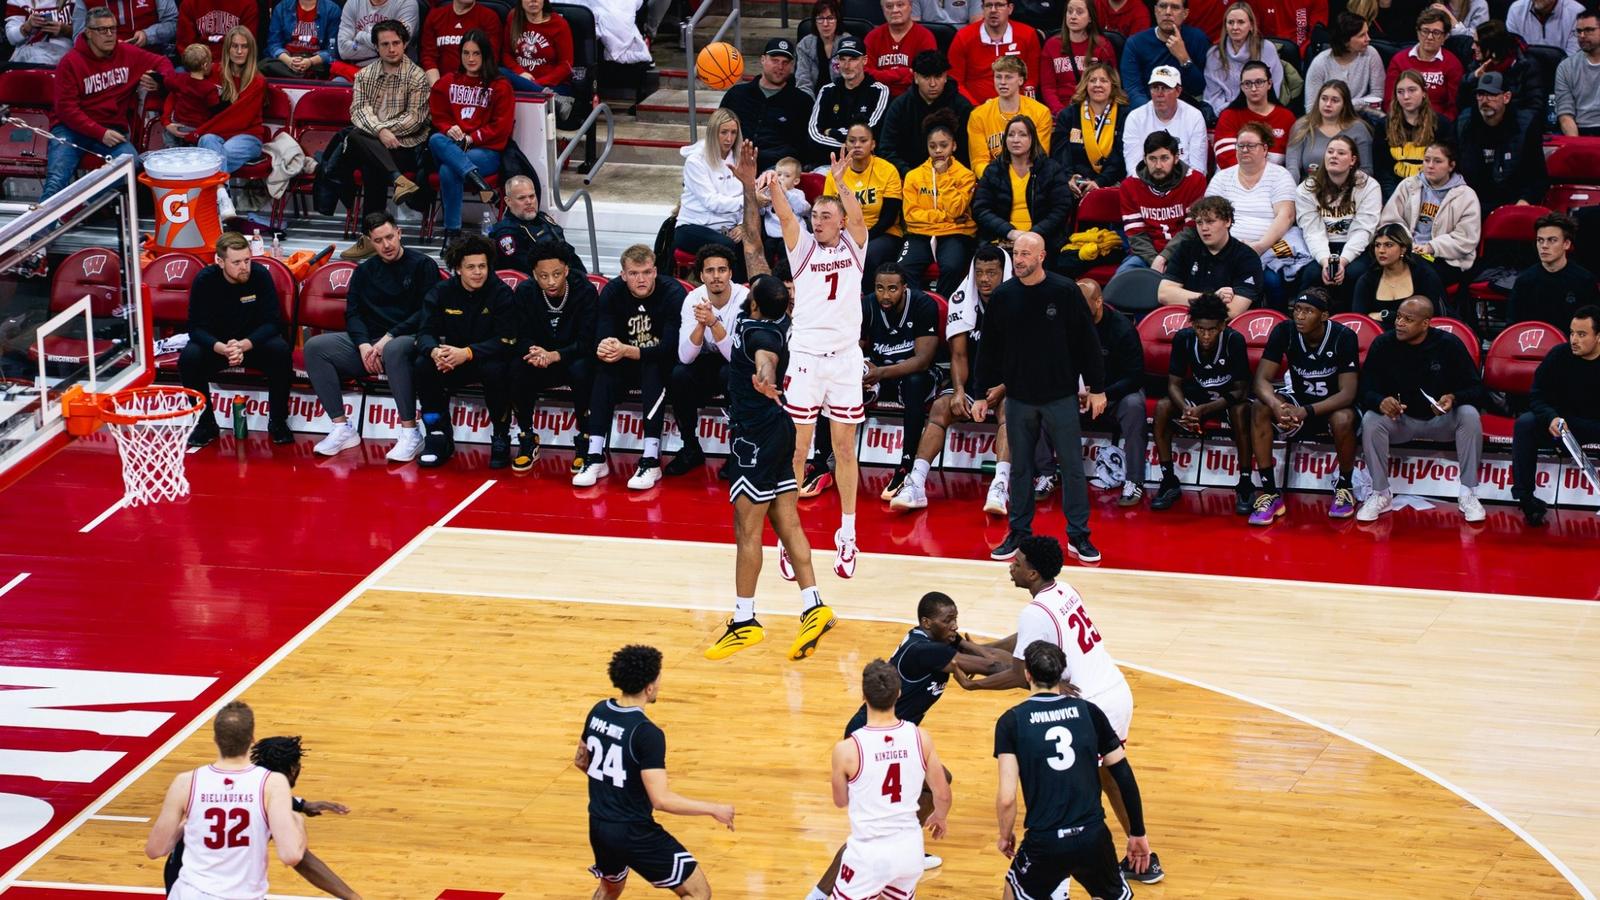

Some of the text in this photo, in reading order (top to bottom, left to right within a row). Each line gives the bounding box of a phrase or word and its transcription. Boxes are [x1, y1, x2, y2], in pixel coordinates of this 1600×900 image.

[162, 193, 190, 224] G
[1140, 203, 1185, 221] WISCONSIN
[810, 258, 852, 273] WISCONSIN
[825, 272, 839, 300] 7
[627, 315, 652, 335] Tilt
[1303, 380, 1329, 397] 25
[1388, 458, 1458, 485] HyVee
[1067, 605, 1102, 655] 25
[1029, 706, 1080, 725] JOVANOVICH
[874, 750, 909, 763] KINZIGER
[1044, 725, 1076, 771] 3
[586, 735, 627, 789] 24
[881, 762, 902, 804] 4
[200, 793, 254, 804] BIELIAUSKAS
[203, 807, 250, 850] 32
